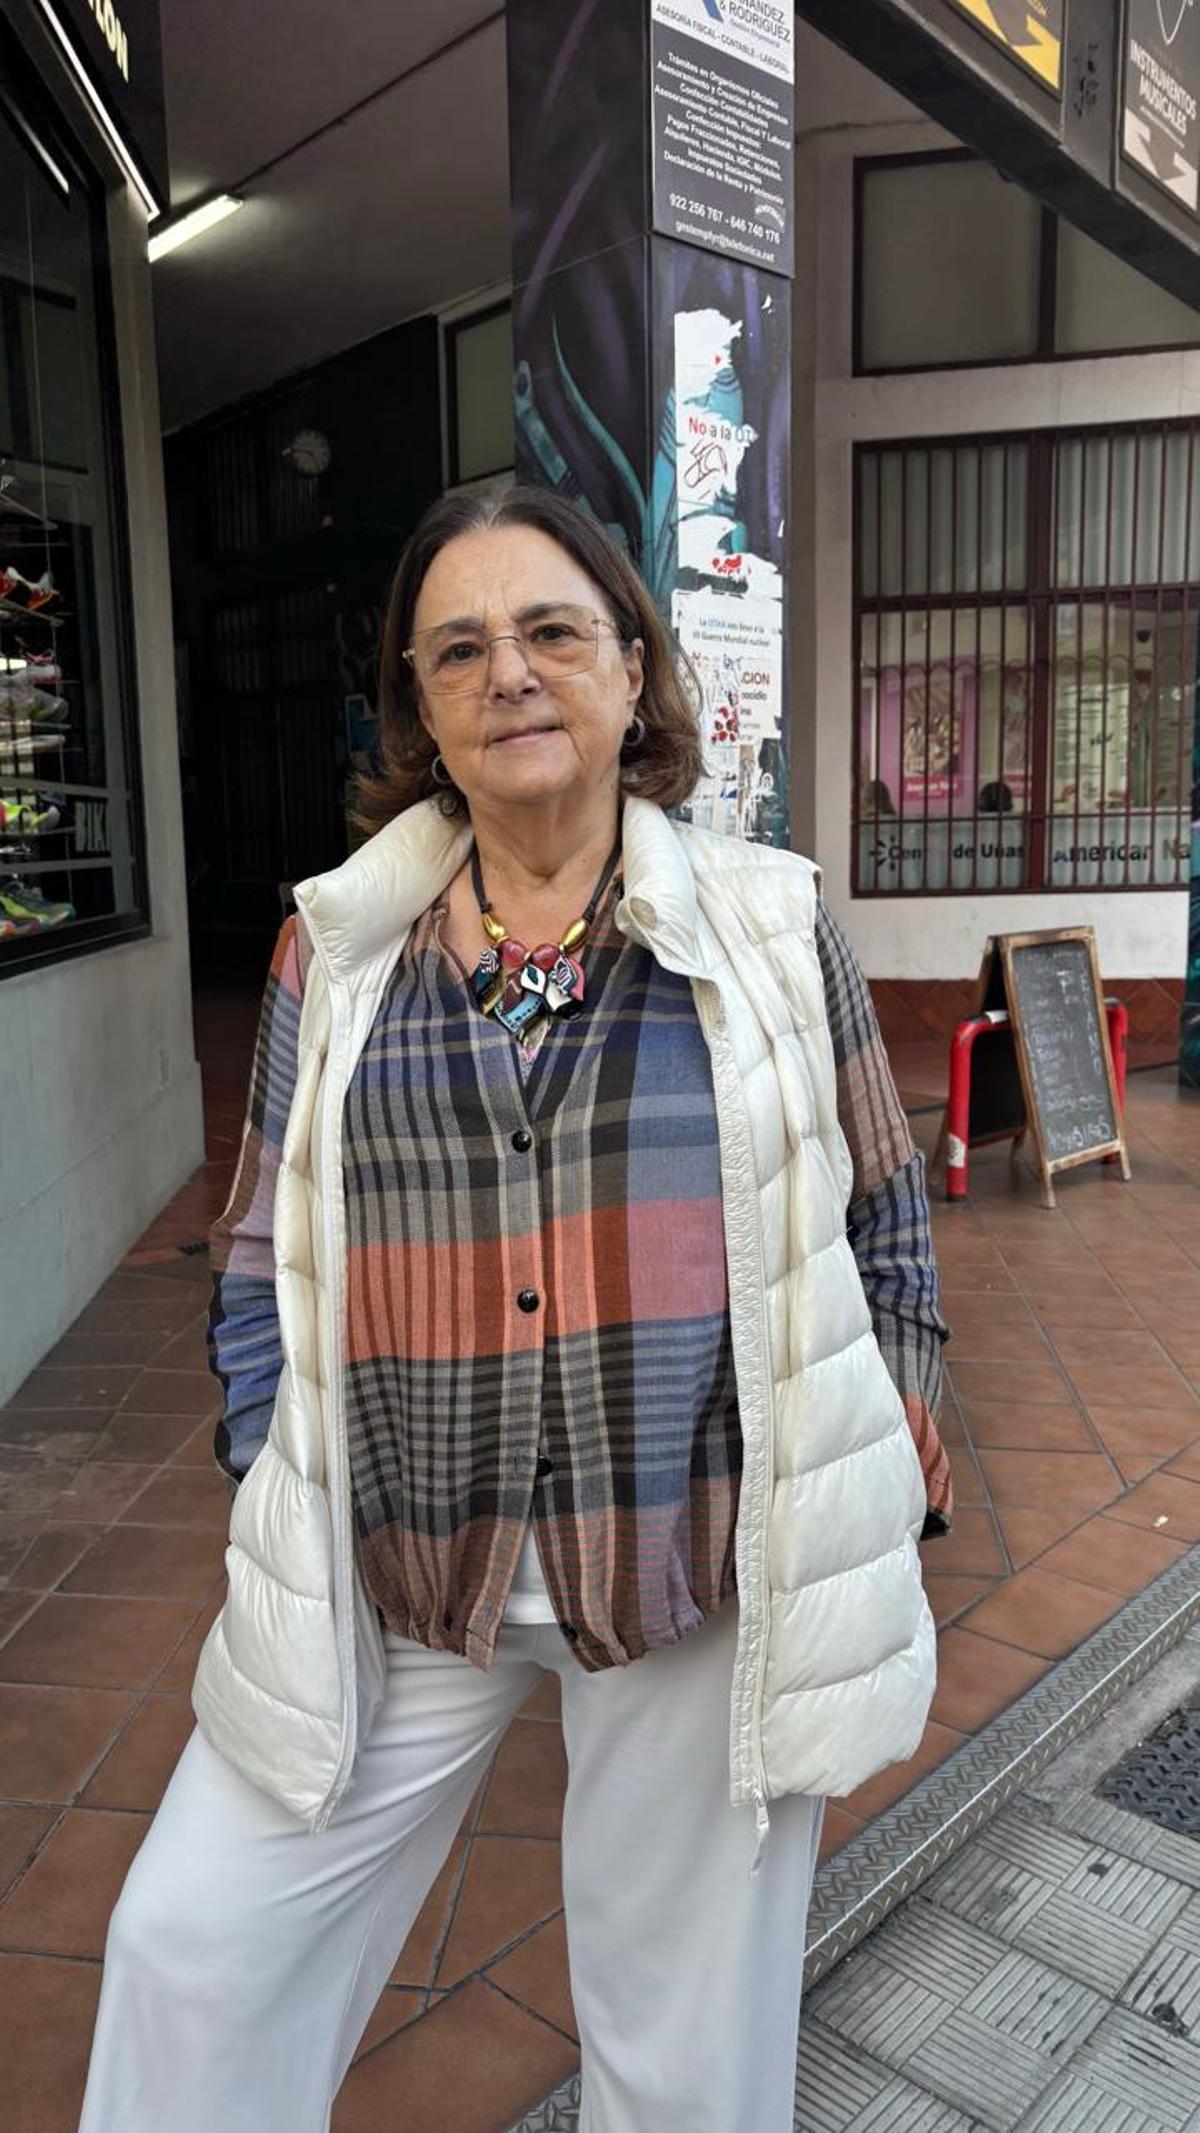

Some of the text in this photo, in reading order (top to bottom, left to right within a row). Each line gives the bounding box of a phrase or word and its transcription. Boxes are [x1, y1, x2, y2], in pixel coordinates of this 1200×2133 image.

[1130, 38, 1196, 120] INSTRUMENTOS
[1139, 74, 1187, 136] MUSICALES
[669, 193, 687, 211] 922
[688, 415, 707, 436] No
[710, 424, 717, 438] a
[720, 425, 731, 441] la
